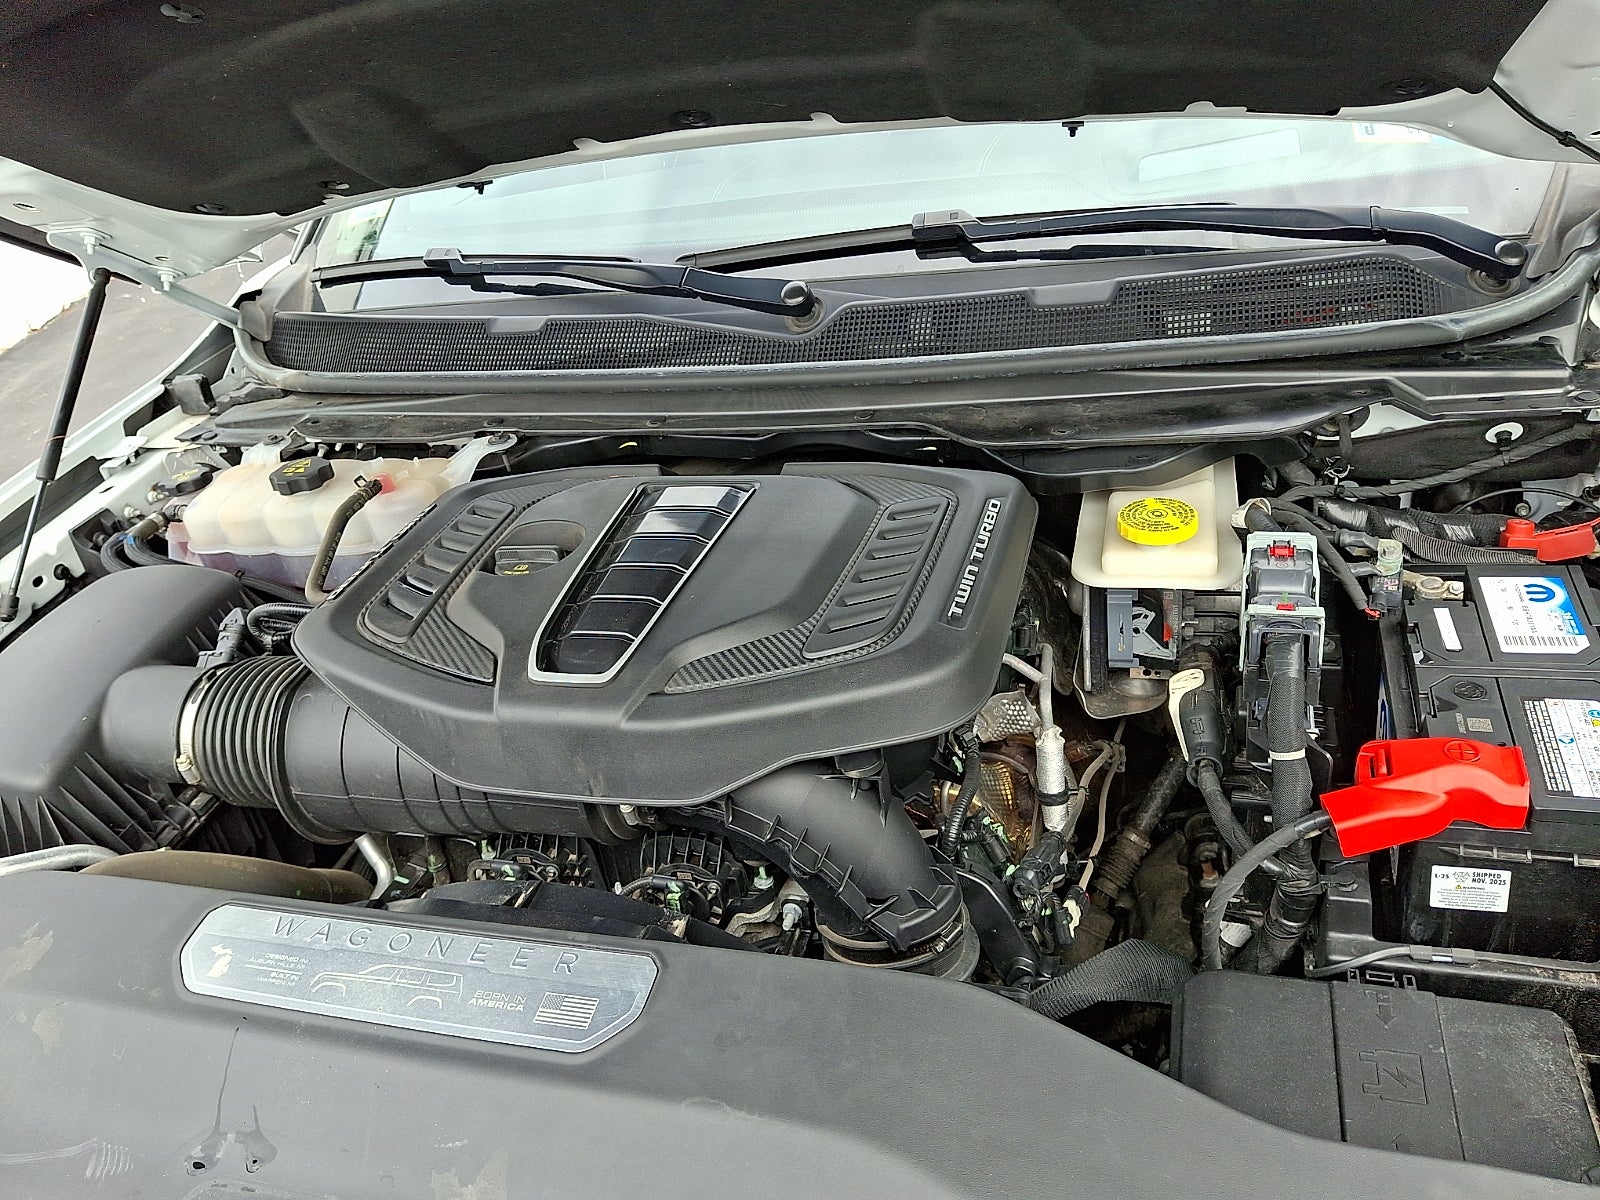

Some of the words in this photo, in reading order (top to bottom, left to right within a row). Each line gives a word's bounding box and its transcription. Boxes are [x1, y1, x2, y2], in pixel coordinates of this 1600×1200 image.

[947, 564, 979, 617] TWIN
[969, 499, 1001, 560] TURBO
[273, 915, 580, 974] WAGONEER
[265, 953, 300, 962] DESIGNED
[467, 997, 524, 1012] AMERICA
[474, 990, 511, 1001] BORN
[513, 995, 527, 1004] IN
